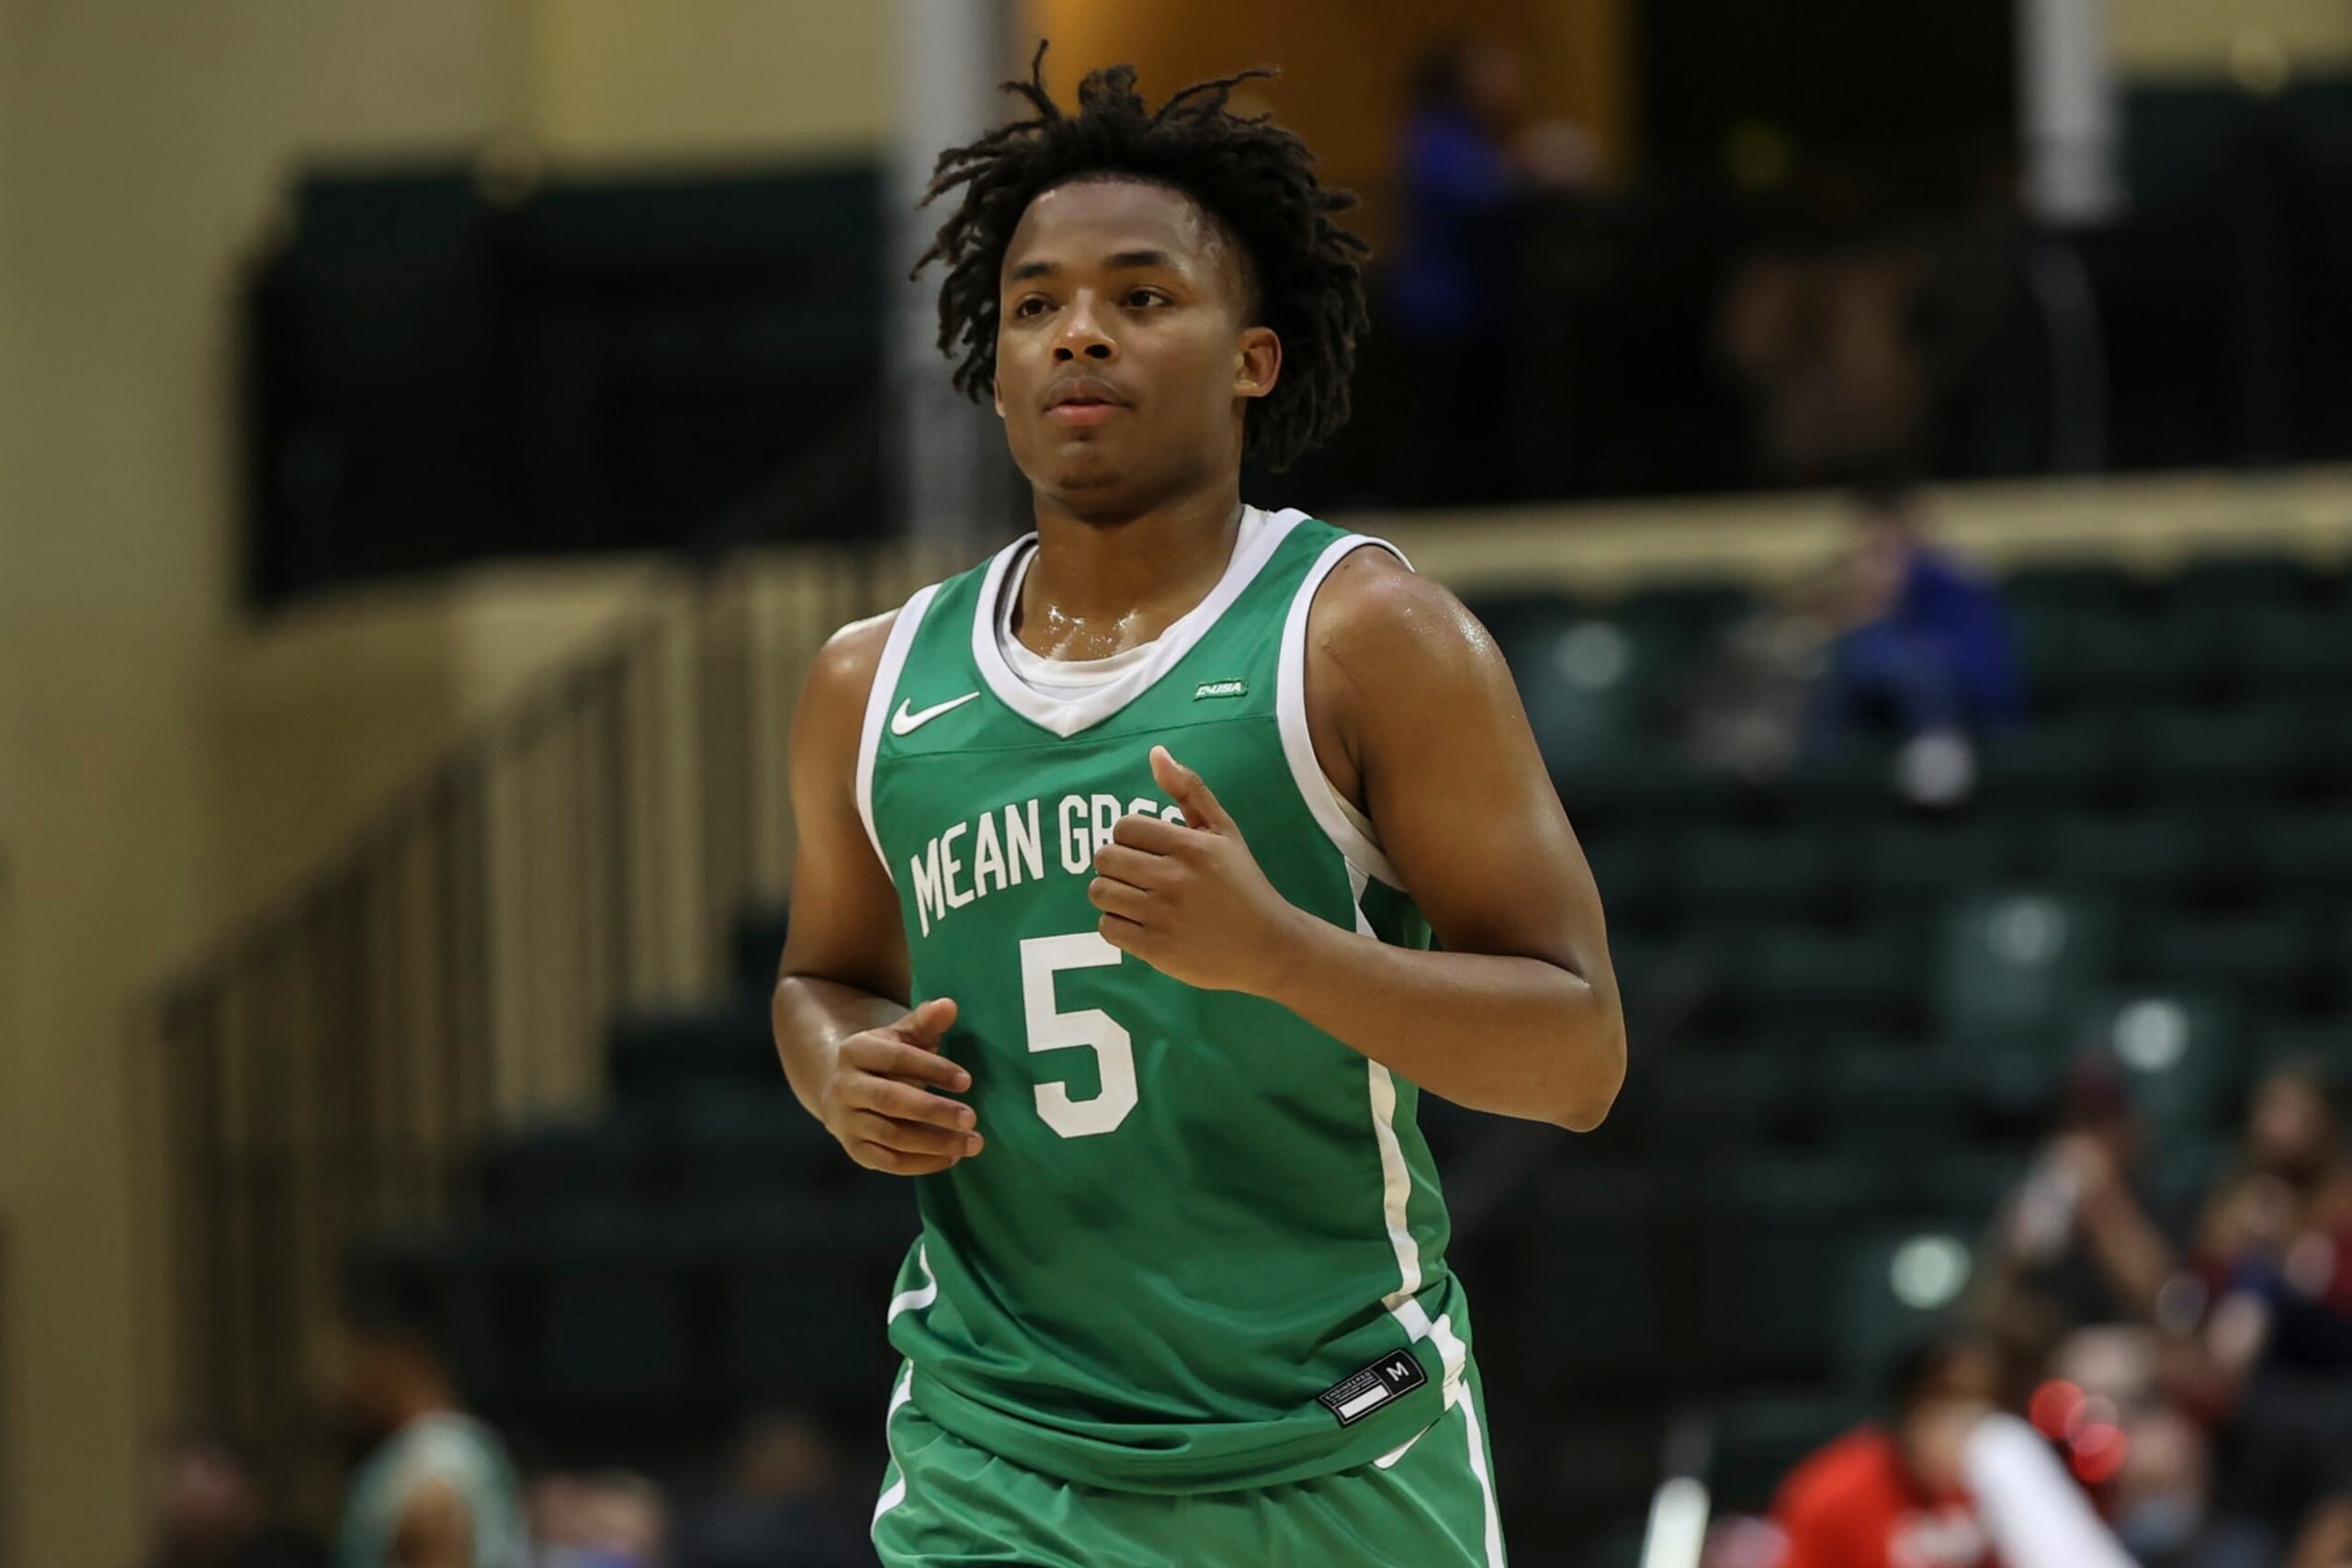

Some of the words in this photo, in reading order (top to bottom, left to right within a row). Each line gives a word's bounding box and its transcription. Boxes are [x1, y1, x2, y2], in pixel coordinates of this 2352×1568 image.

[910, 798, 1045, 939] MEAN
[1020, 931, 1139, 1139] 5
[1385, 1361, 1410, 1382] M
